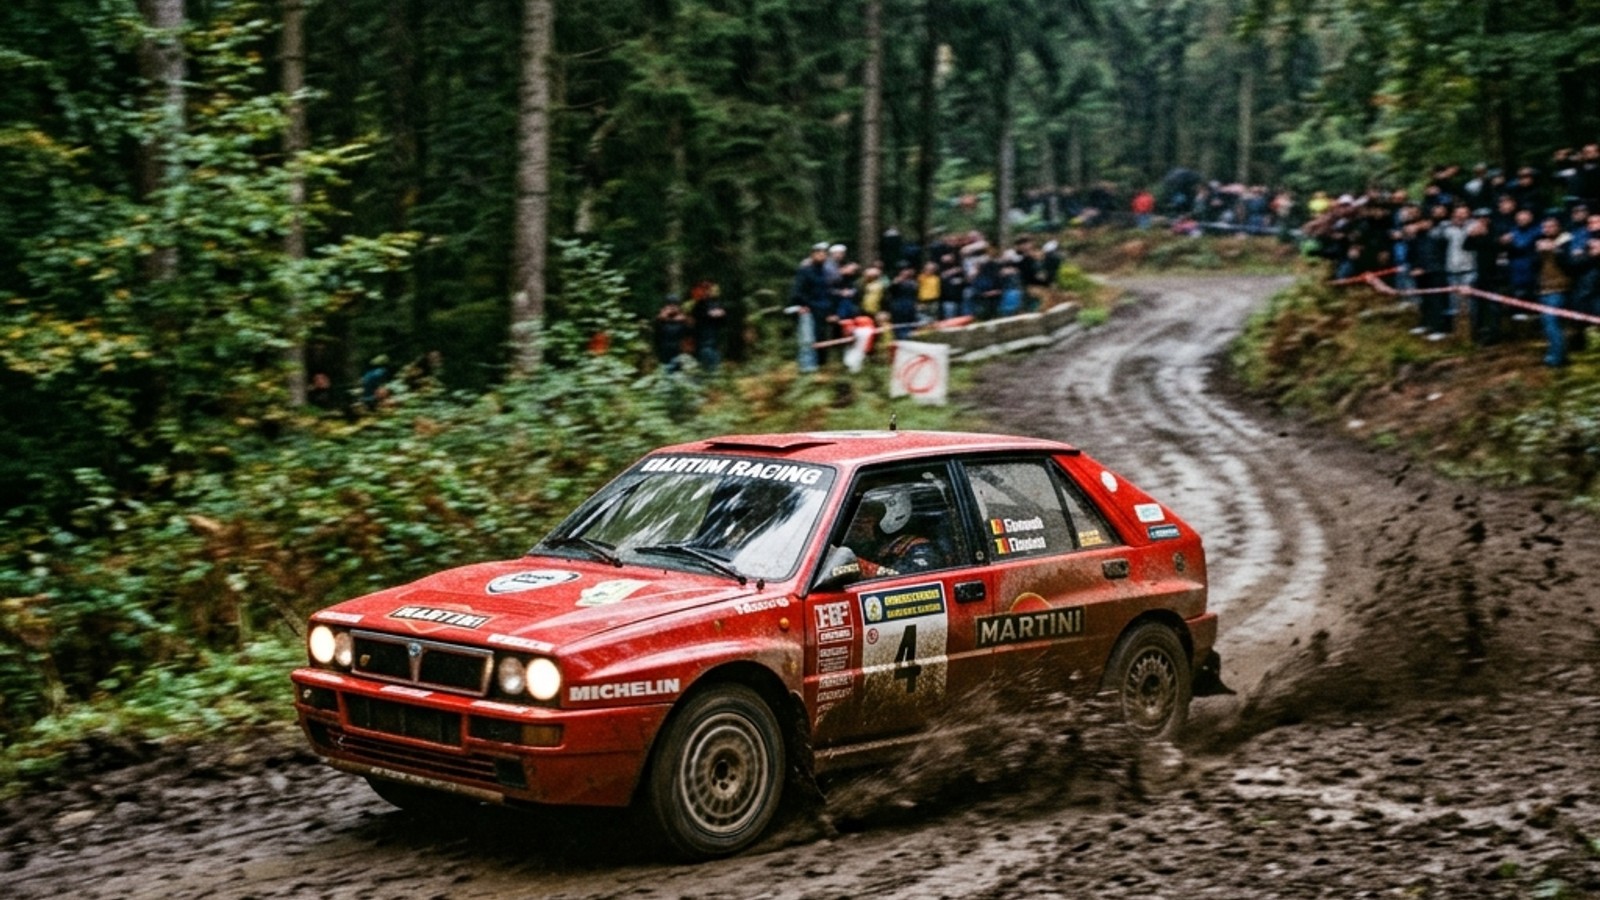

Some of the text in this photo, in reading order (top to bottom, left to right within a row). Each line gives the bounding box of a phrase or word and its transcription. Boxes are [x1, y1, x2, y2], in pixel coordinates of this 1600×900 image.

[727, 460, 823, 485] RACING
[981, 609, 1081, 644] MARTINI
[894, 624, 921, 693] 4
[569, 678, 680, 701] MICHELIN
